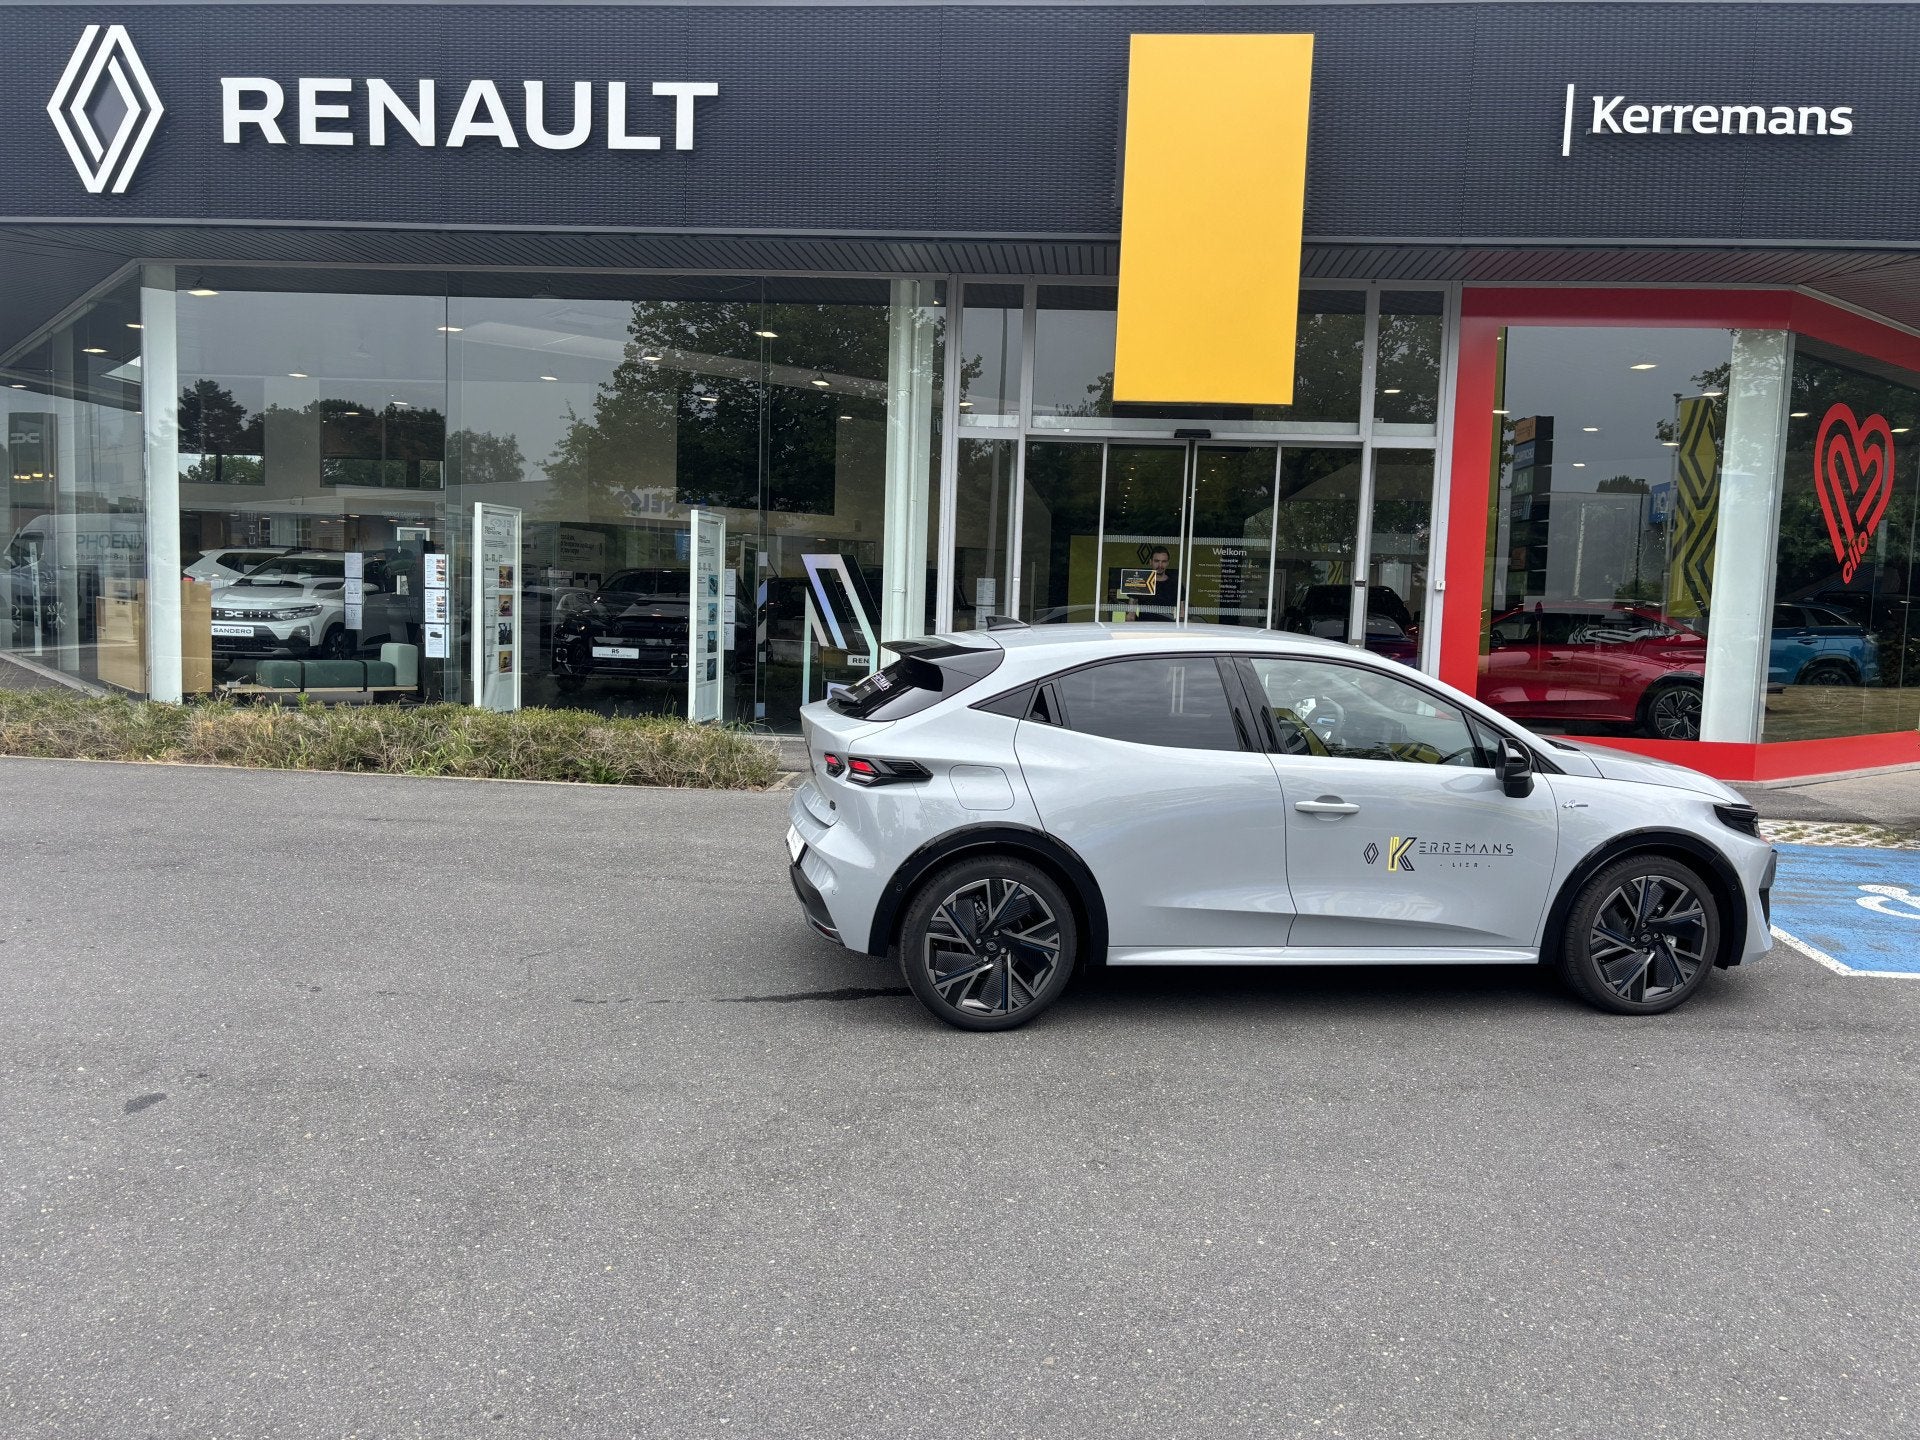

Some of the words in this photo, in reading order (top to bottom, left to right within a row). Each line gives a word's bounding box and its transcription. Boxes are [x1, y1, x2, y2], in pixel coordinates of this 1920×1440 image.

[220, 77, 719, 151] RENAULT
[1592, 95, 1854, 136] Kerremans
[1212, 547, 1248, 556] Welkom
[1842, 531, 1868, 585] clio
[212, 627, 253, 636] SANDERO
[1388, 836, 1515, 872] KERREMANS
